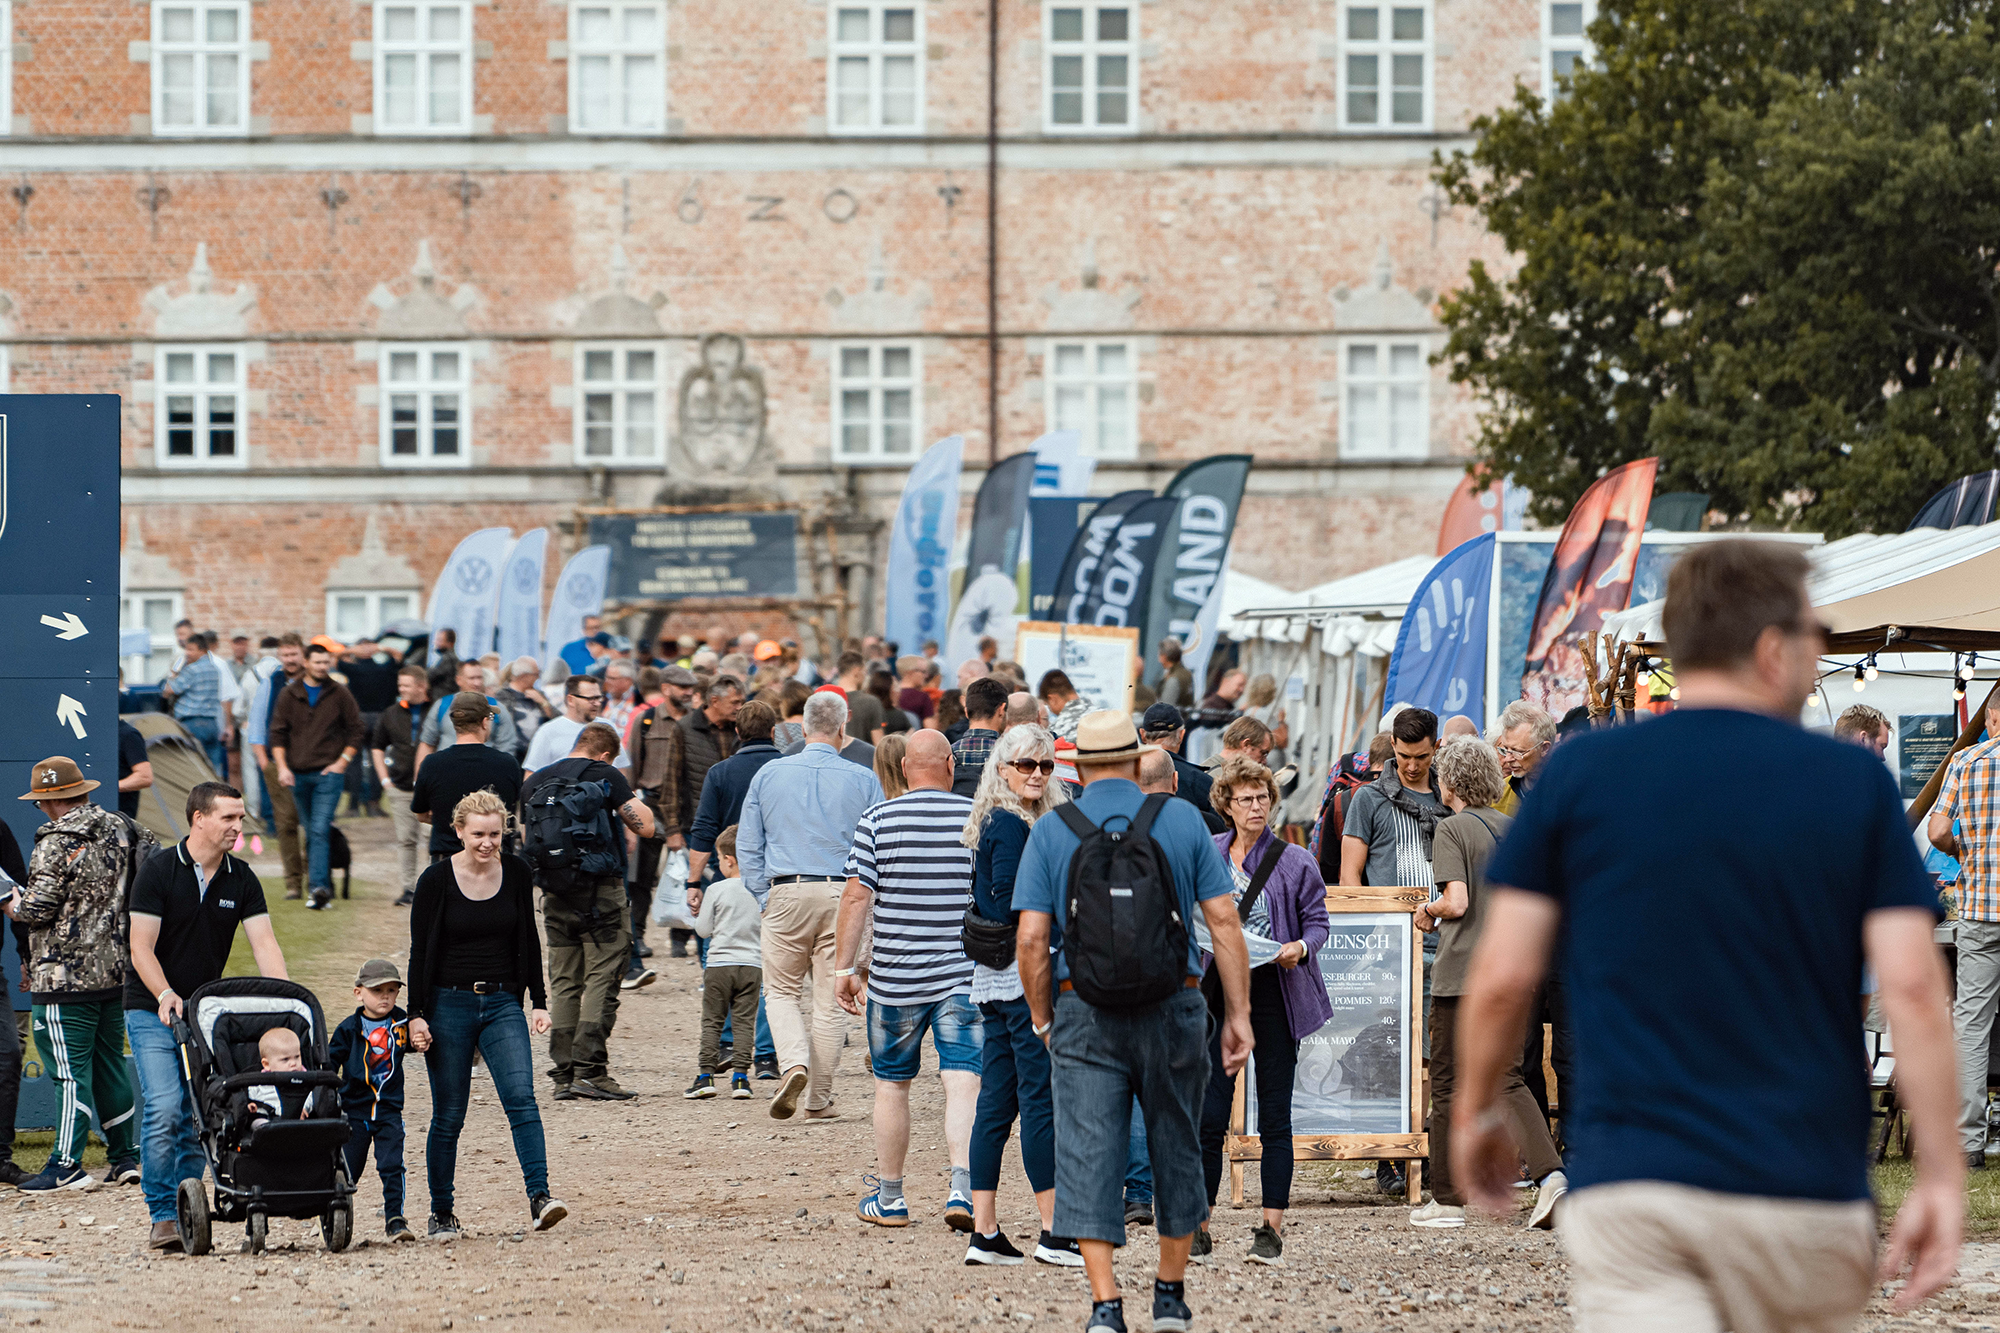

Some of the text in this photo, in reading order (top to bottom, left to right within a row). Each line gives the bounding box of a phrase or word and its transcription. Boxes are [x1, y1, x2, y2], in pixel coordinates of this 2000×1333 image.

[1322, 972, 1371, 981] ESEBURGER
[1335, 996, 1372, 1005] POMMES
[1331, 1036, 1356, 1045] MAYO
